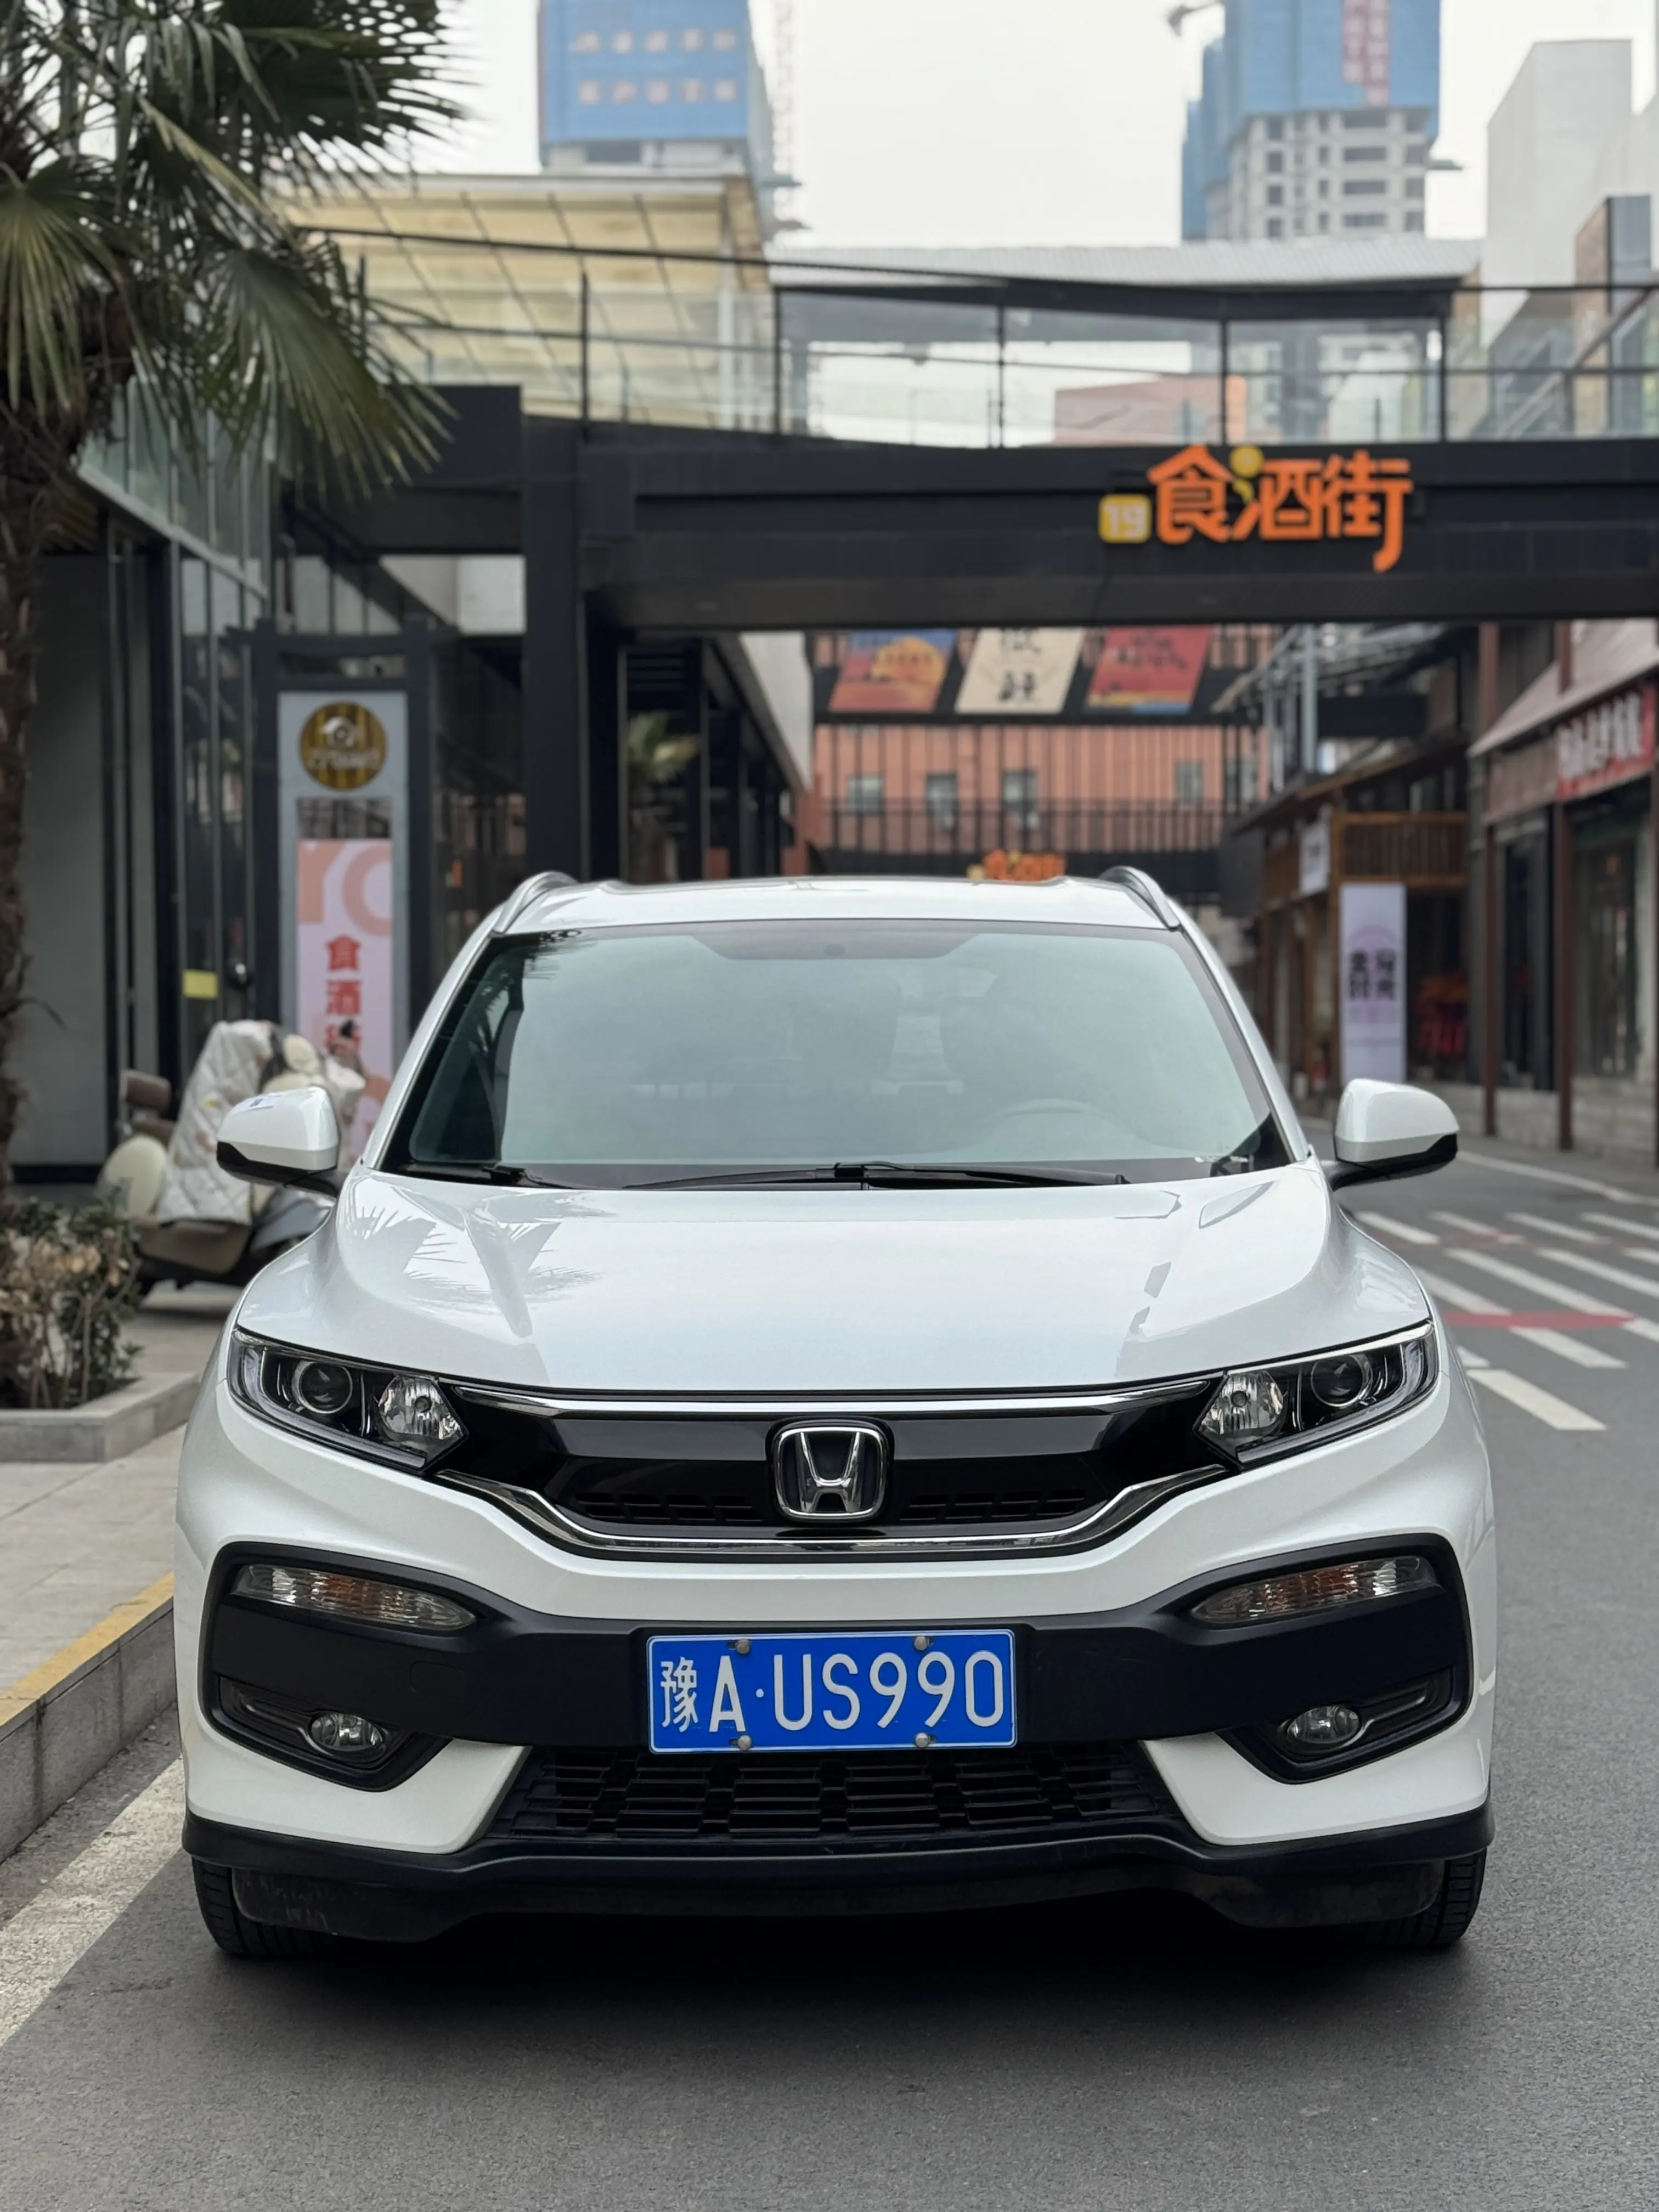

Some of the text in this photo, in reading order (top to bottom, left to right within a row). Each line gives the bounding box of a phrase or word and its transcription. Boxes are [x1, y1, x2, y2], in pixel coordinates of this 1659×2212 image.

[1104, 443, 1413, 573] 19 食酒街
[660, 1650, 1004, 1733] 豫A·US990
